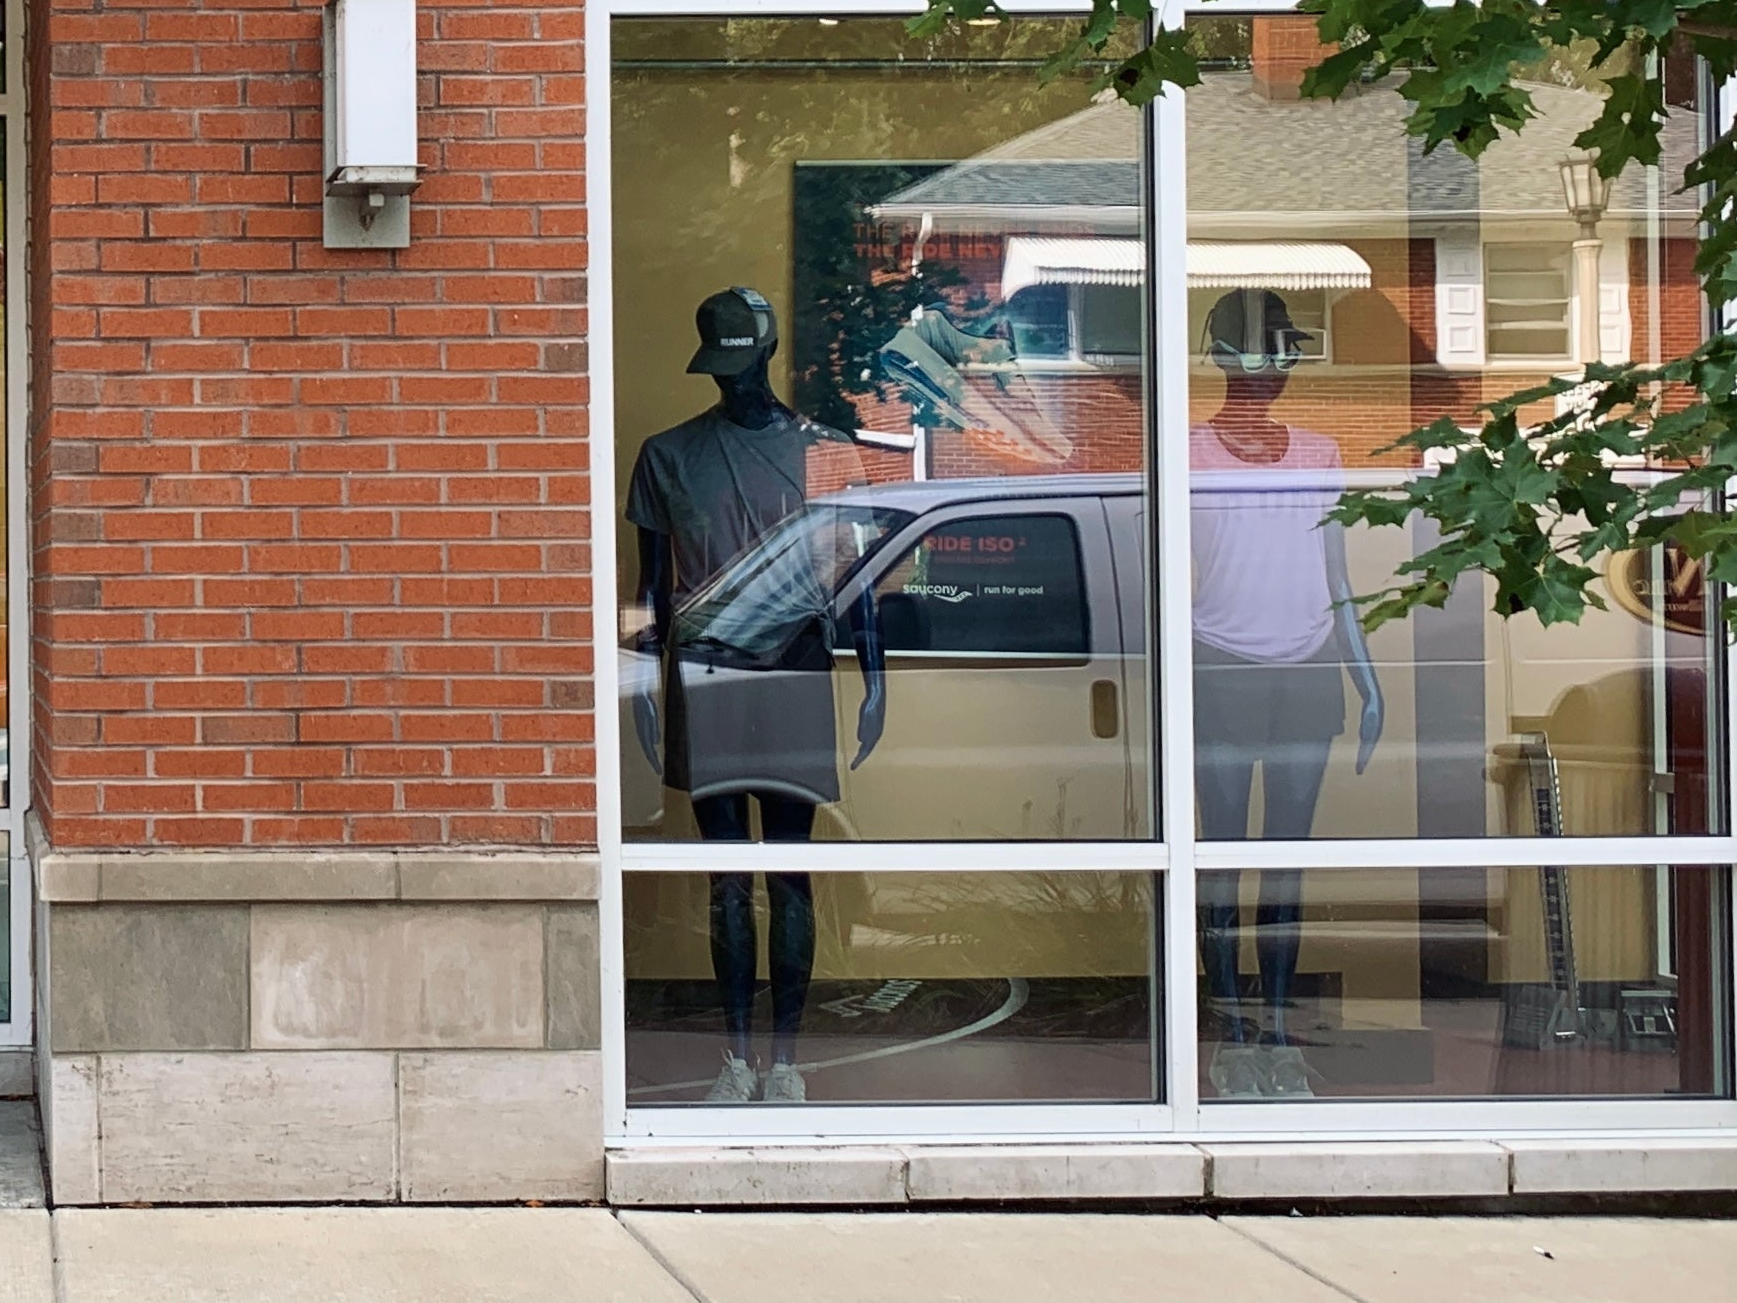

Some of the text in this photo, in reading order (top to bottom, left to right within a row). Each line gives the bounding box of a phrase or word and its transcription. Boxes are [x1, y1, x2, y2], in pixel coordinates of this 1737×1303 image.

[902, 244, 952, 258] RDE
[720, 337, 754, 347] RUNNER
[924, 536, 972, 552] RIDE
[978, 536, 1015, 552] ISO
[902, 584, 1044, 596] saucony run for good
